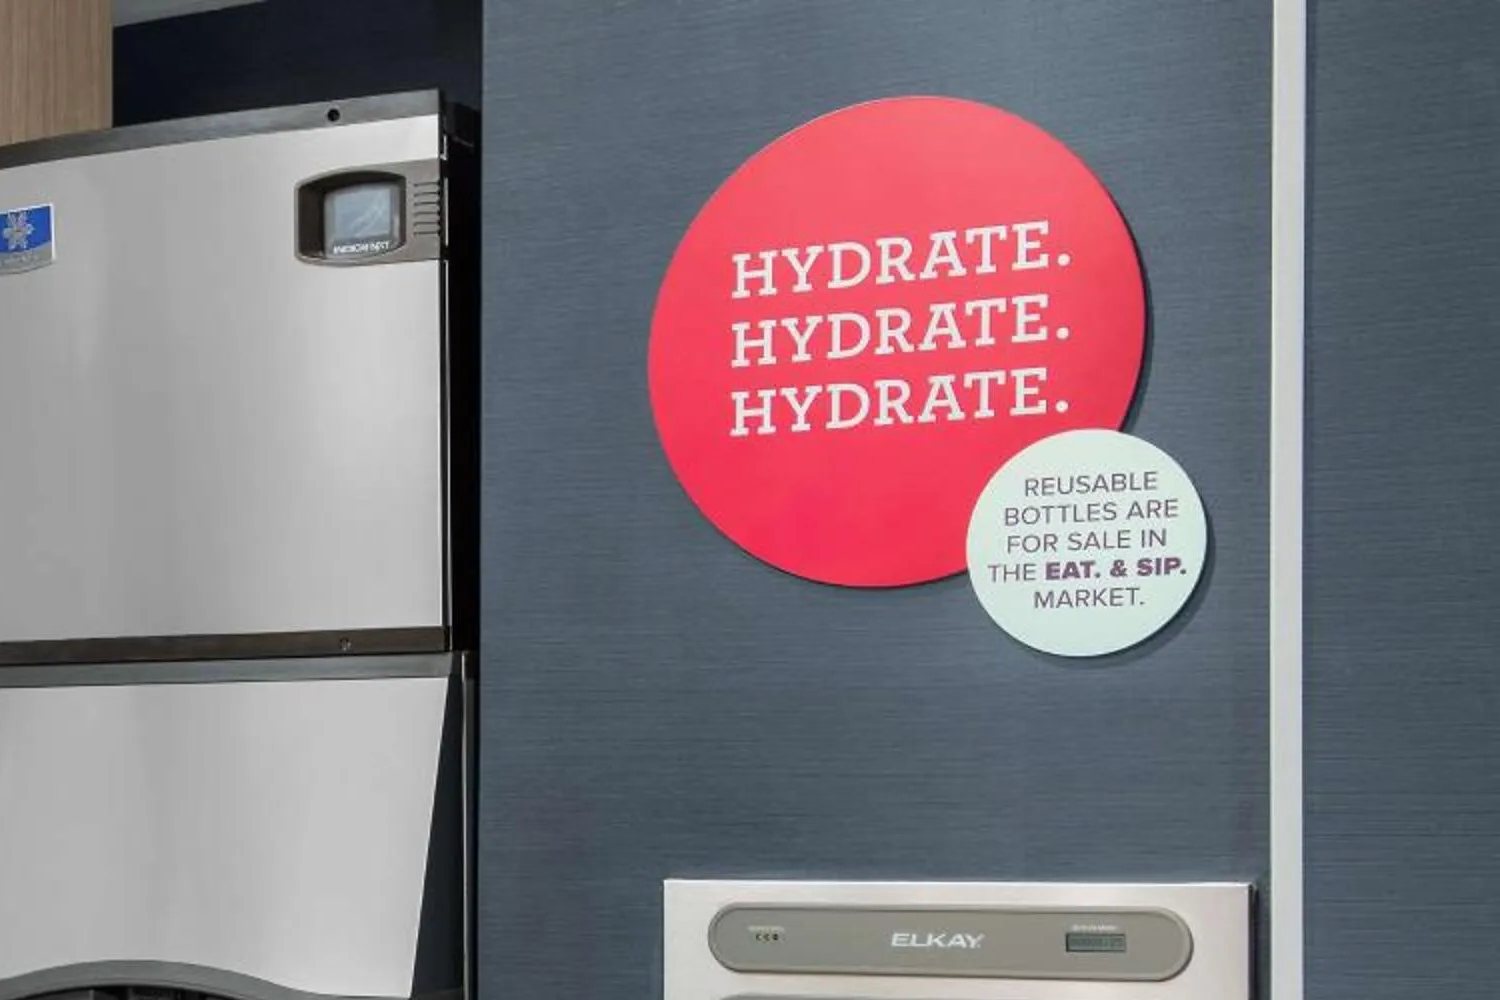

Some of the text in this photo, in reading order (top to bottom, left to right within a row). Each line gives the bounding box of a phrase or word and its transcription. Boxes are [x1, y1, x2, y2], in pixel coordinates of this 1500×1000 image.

[731, 219, 1072, 299] HYDRATE.
[731, 293, 1071, 368] HYDRATE.
[729, 366, 1070, 438] HYDRATE.
[1024, 470, 1159, 498] REUSABLE
[1004, 498, 1179, 527] BOTTLES ARE
[1006, 527, 1168, 555] FOR SALE IN
[987, 556, 1188, 584] THE EAT. & SIP.
[1033, 586, 1145, 610] MARKET.
[891, 931, 986, 949] ELKAY
